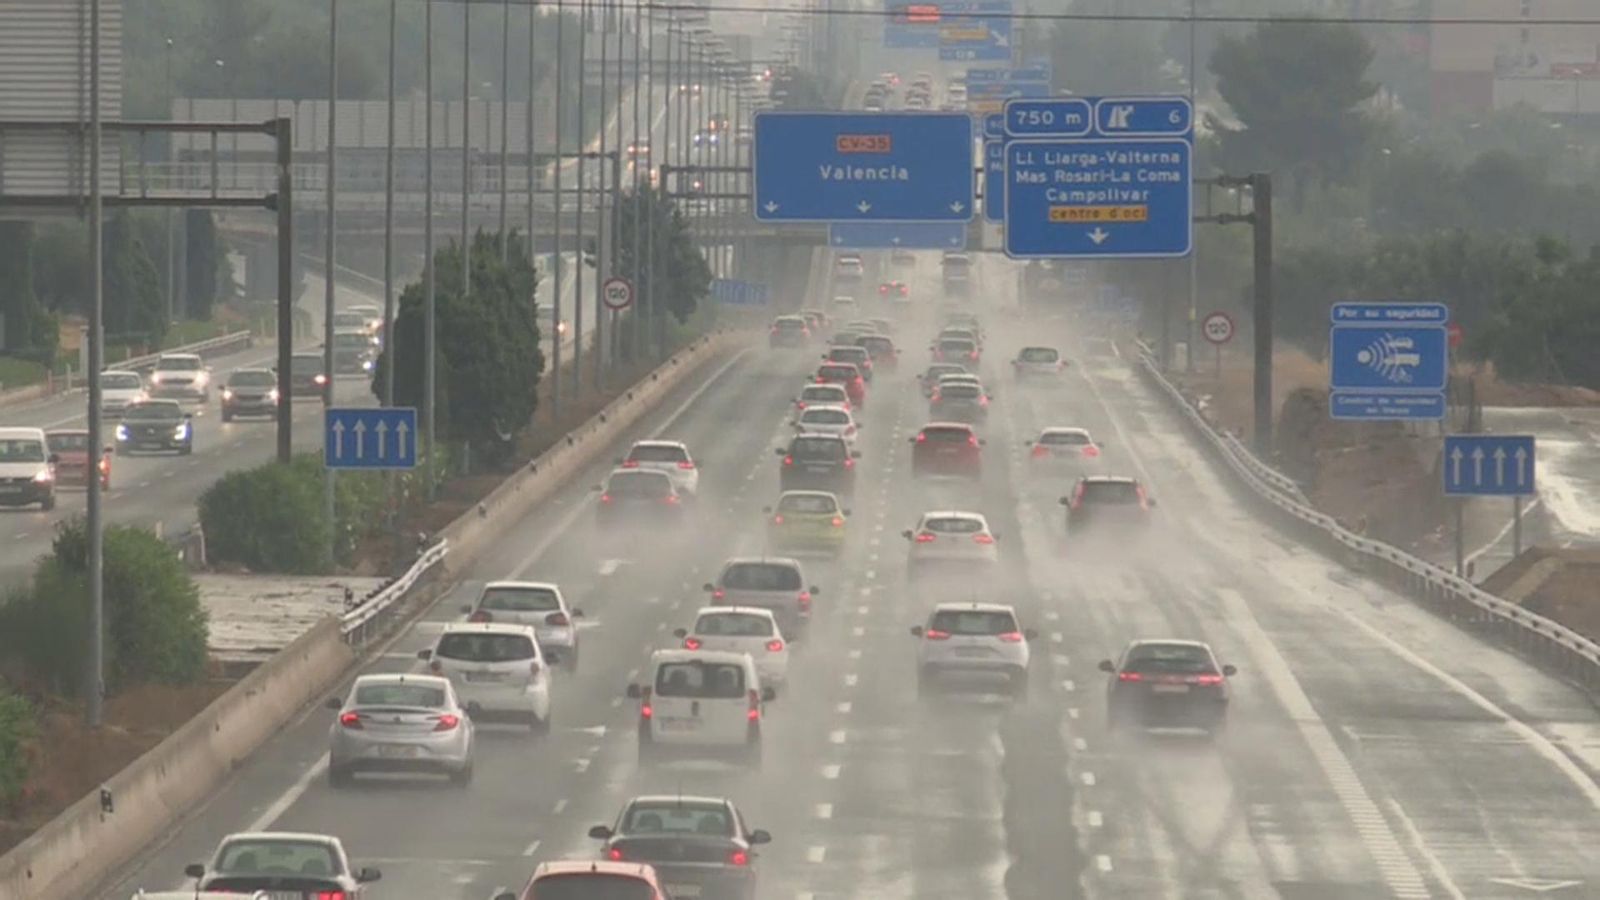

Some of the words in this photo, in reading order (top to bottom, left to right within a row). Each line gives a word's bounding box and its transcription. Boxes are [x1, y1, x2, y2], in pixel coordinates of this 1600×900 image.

[1016, 111, 1053, 125] 750
[1066, 113, 1081, 124] m
[1168, 110, 1181, 123] 6
[839, 137, 887, 149] CV-35
[820, 164, 909, 180] Valencia
[1016, 170, 1047, 183] Mas
[1137, 168, 1181, 182] Coma
[1046, 187, 1149, 203] Campolivar
[1051, 209, 1100, 219] centre
[607, 287, 628, 299] 120
[1208, 322, 1229, 334] 120
